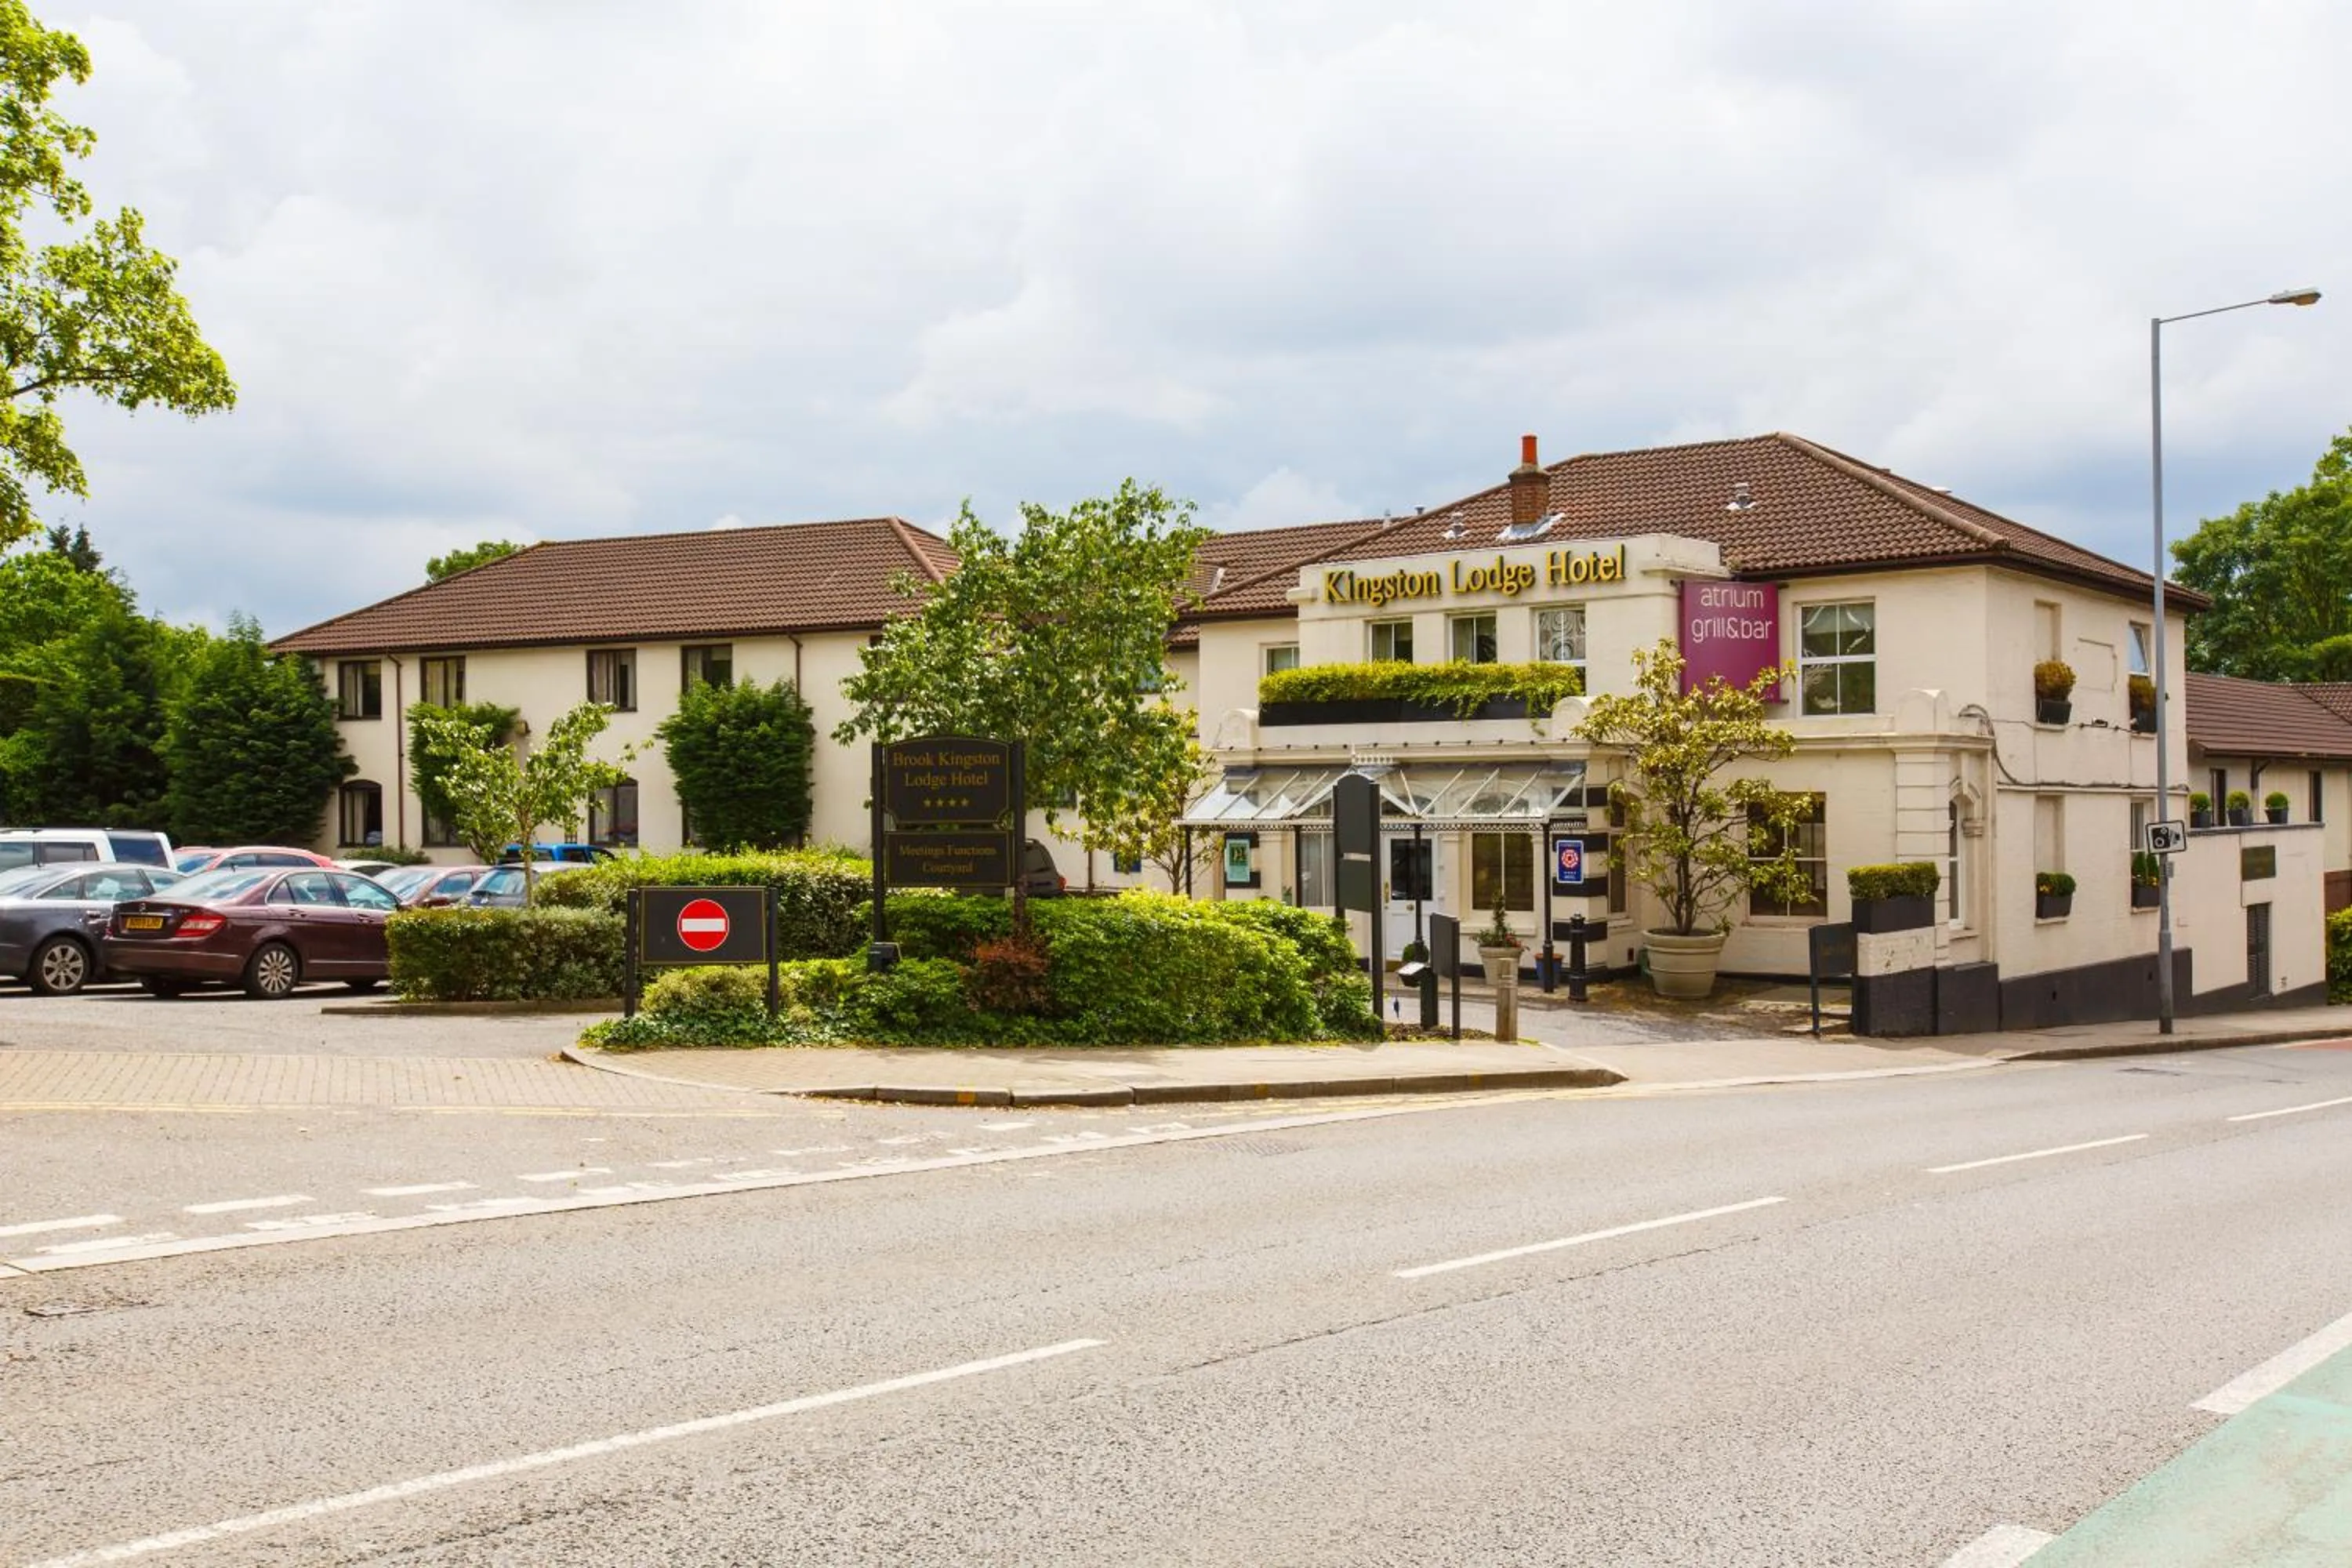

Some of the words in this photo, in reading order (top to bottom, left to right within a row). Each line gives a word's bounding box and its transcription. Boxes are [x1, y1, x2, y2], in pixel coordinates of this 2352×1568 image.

[1323, 568, 1443, 607] Kingston
[1448, 555, 1535, 597] Lodge
[1545, 543, 1626, 586] Hotel
[1700, 586, 1764, 608] atrium
[1691, 617, 1773, 643] grill&bar
[893, 752, 935, 766] Brook
[938, 752, 1000, 769] Kingston
[905, 772, 947, 789] Lodge
[951, 771, 989, 786] Hotel
